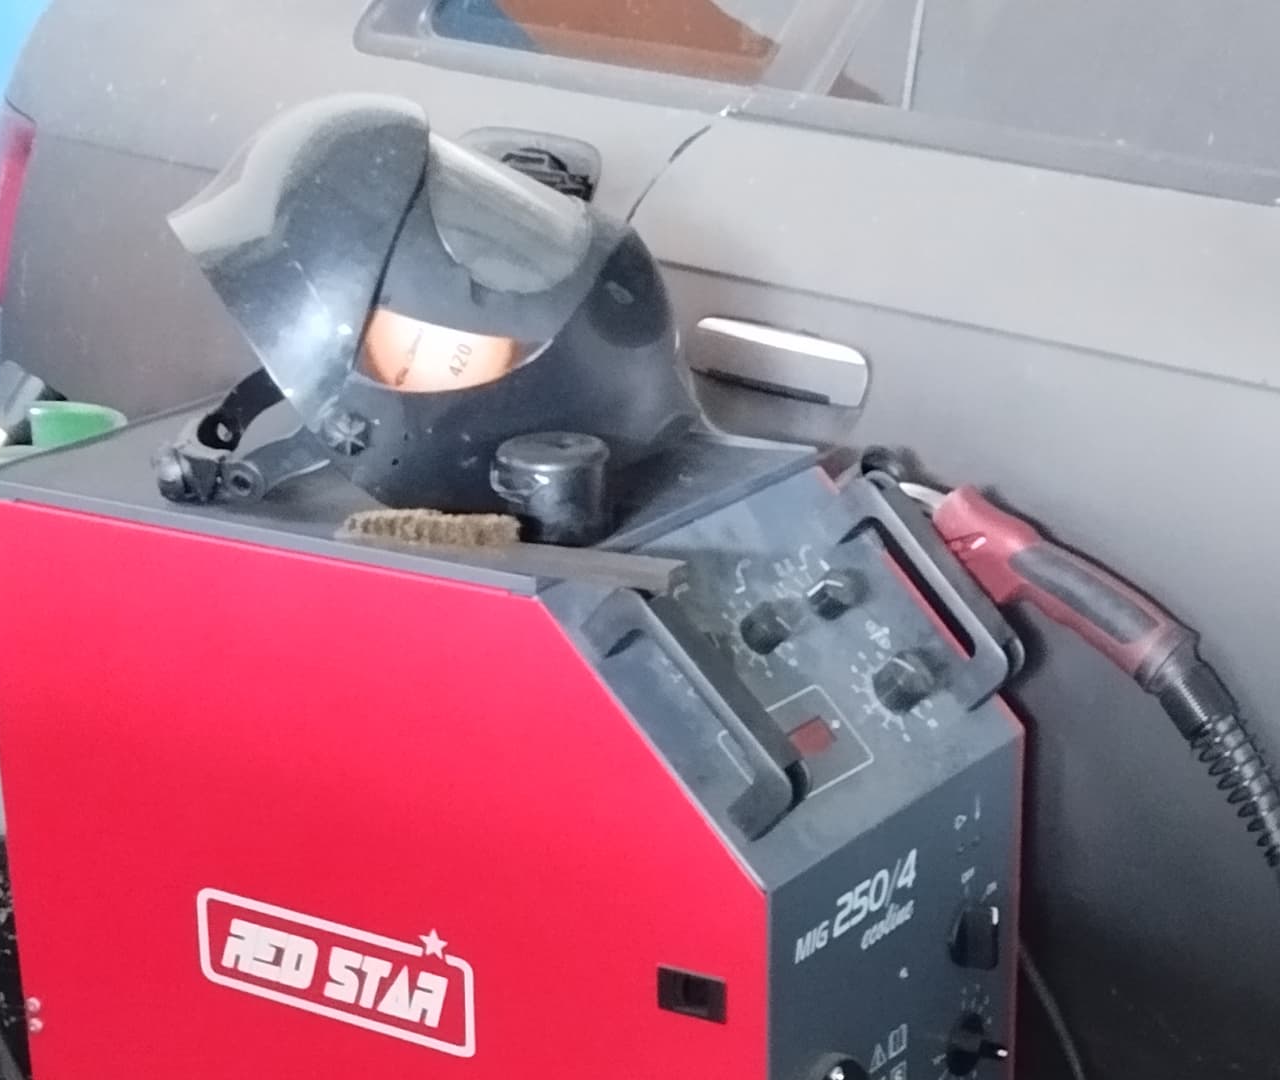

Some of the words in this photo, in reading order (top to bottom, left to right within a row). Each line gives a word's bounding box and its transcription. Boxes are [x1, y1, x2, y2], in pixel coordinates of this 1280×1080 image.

[794, 919, 830, 964] MIG
[832, 847, 917, 938] 250/4
[221, 918, 319, 989] RED
[323, 946, 448, 1028] STAR
